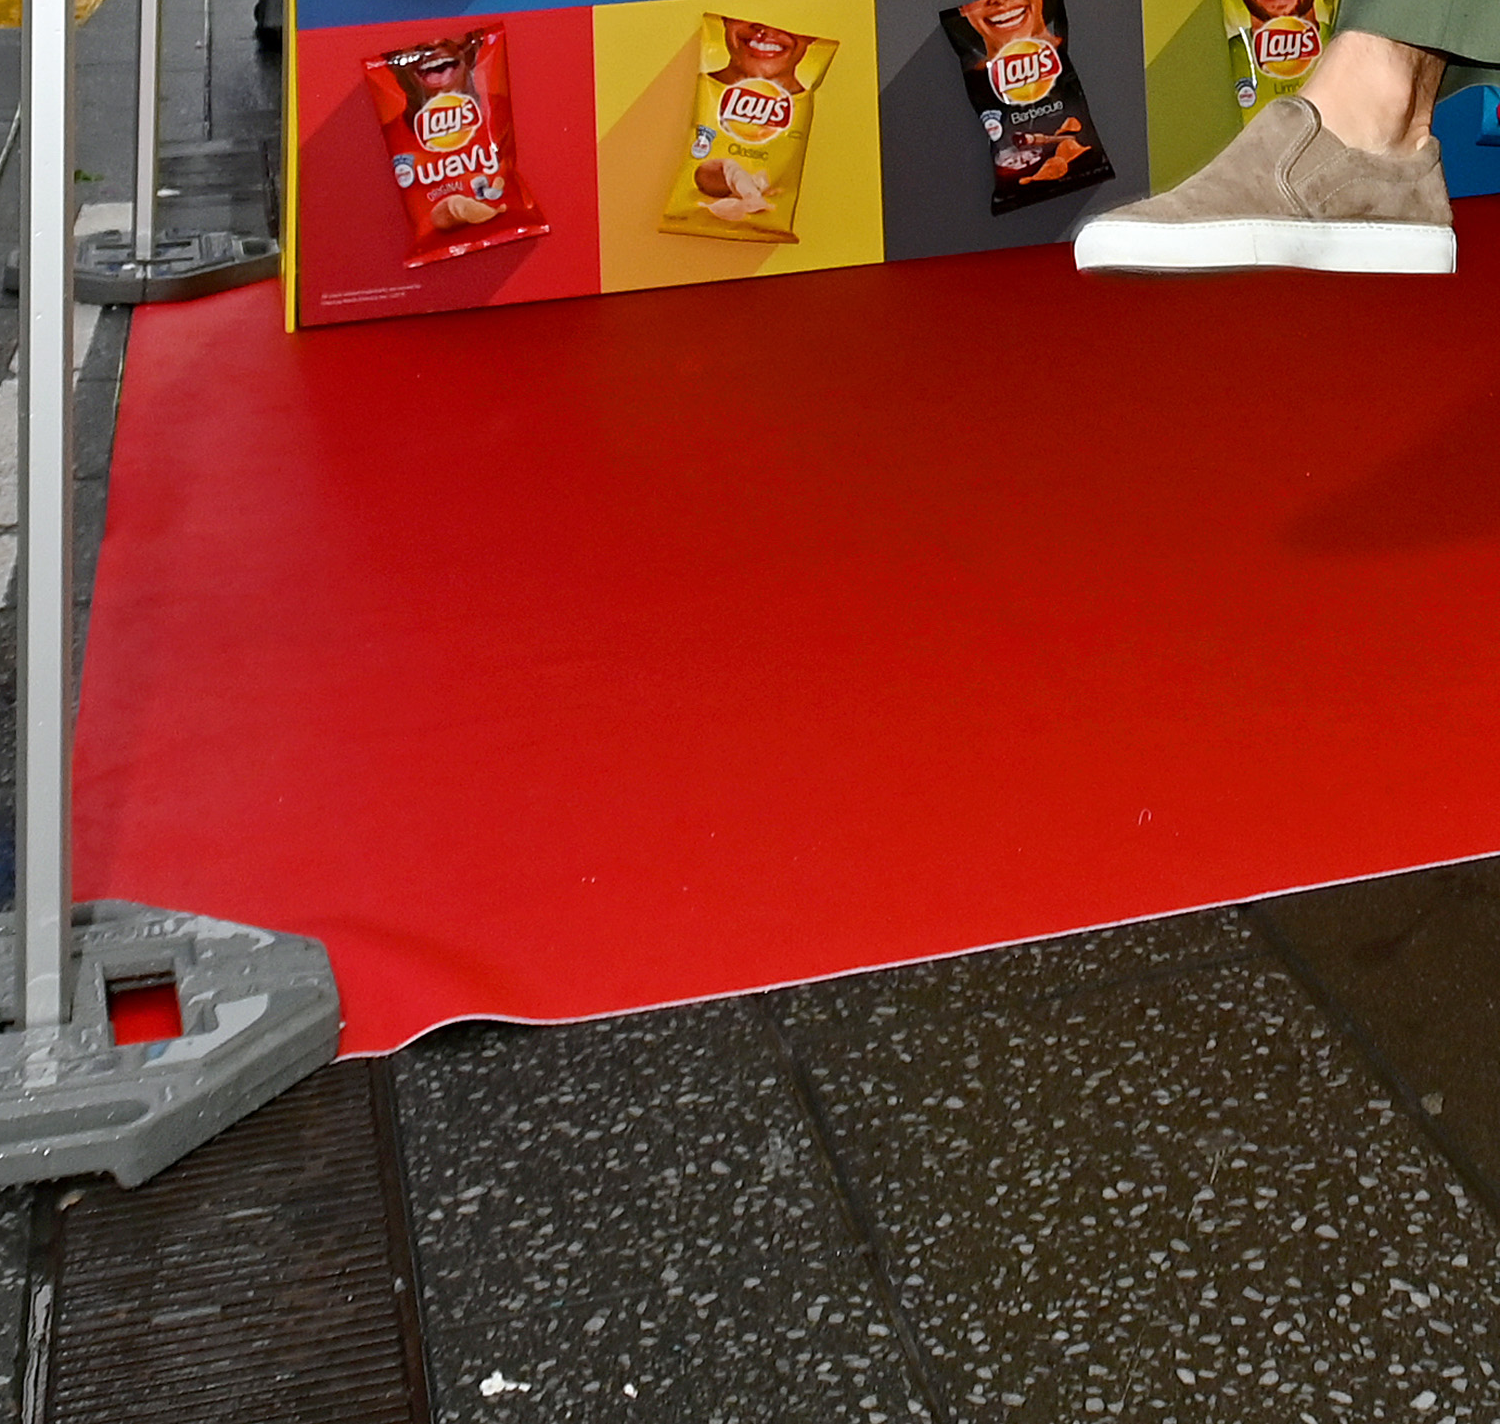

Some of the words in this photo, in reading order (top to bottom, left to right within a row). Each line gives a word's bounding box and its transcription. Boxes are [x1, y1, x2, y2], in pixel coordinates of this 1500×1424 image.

[1260, 29, 1315, 62] Lay's
[997, 47, 1053, 92] Lay's
[423, 101, 475, 140] Lay's
[722, 88, 788, 125] Lay's
[1011, 100, 1064, 125] Barbecue
[417, 145, 499, 184] wavy
[728, 143, 769, 161] Classic
